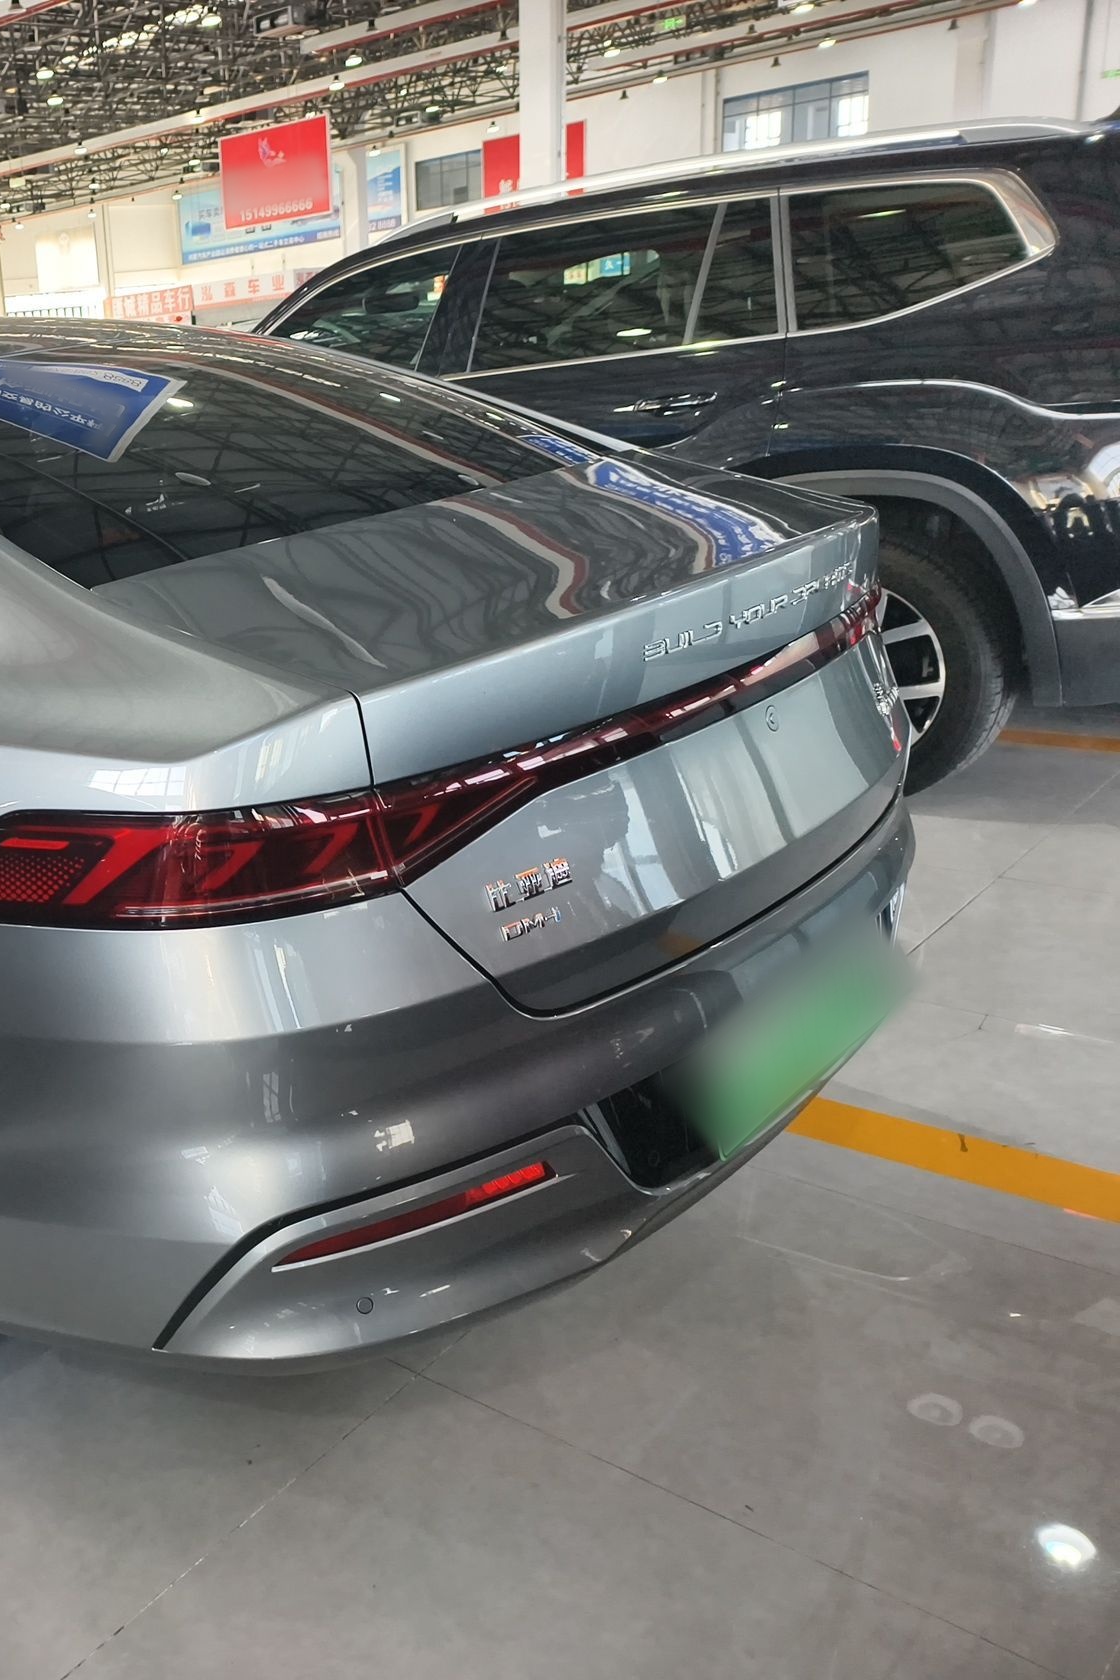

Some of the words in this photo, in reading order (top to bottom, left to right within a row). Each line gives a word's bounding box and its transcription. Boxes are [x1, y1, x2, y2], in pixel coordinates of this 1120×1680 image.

[240, 199, 313, 223] 15149966666
[643, 621, 723, 662] BUILD
[729, 594, 789, 630] YOUR
